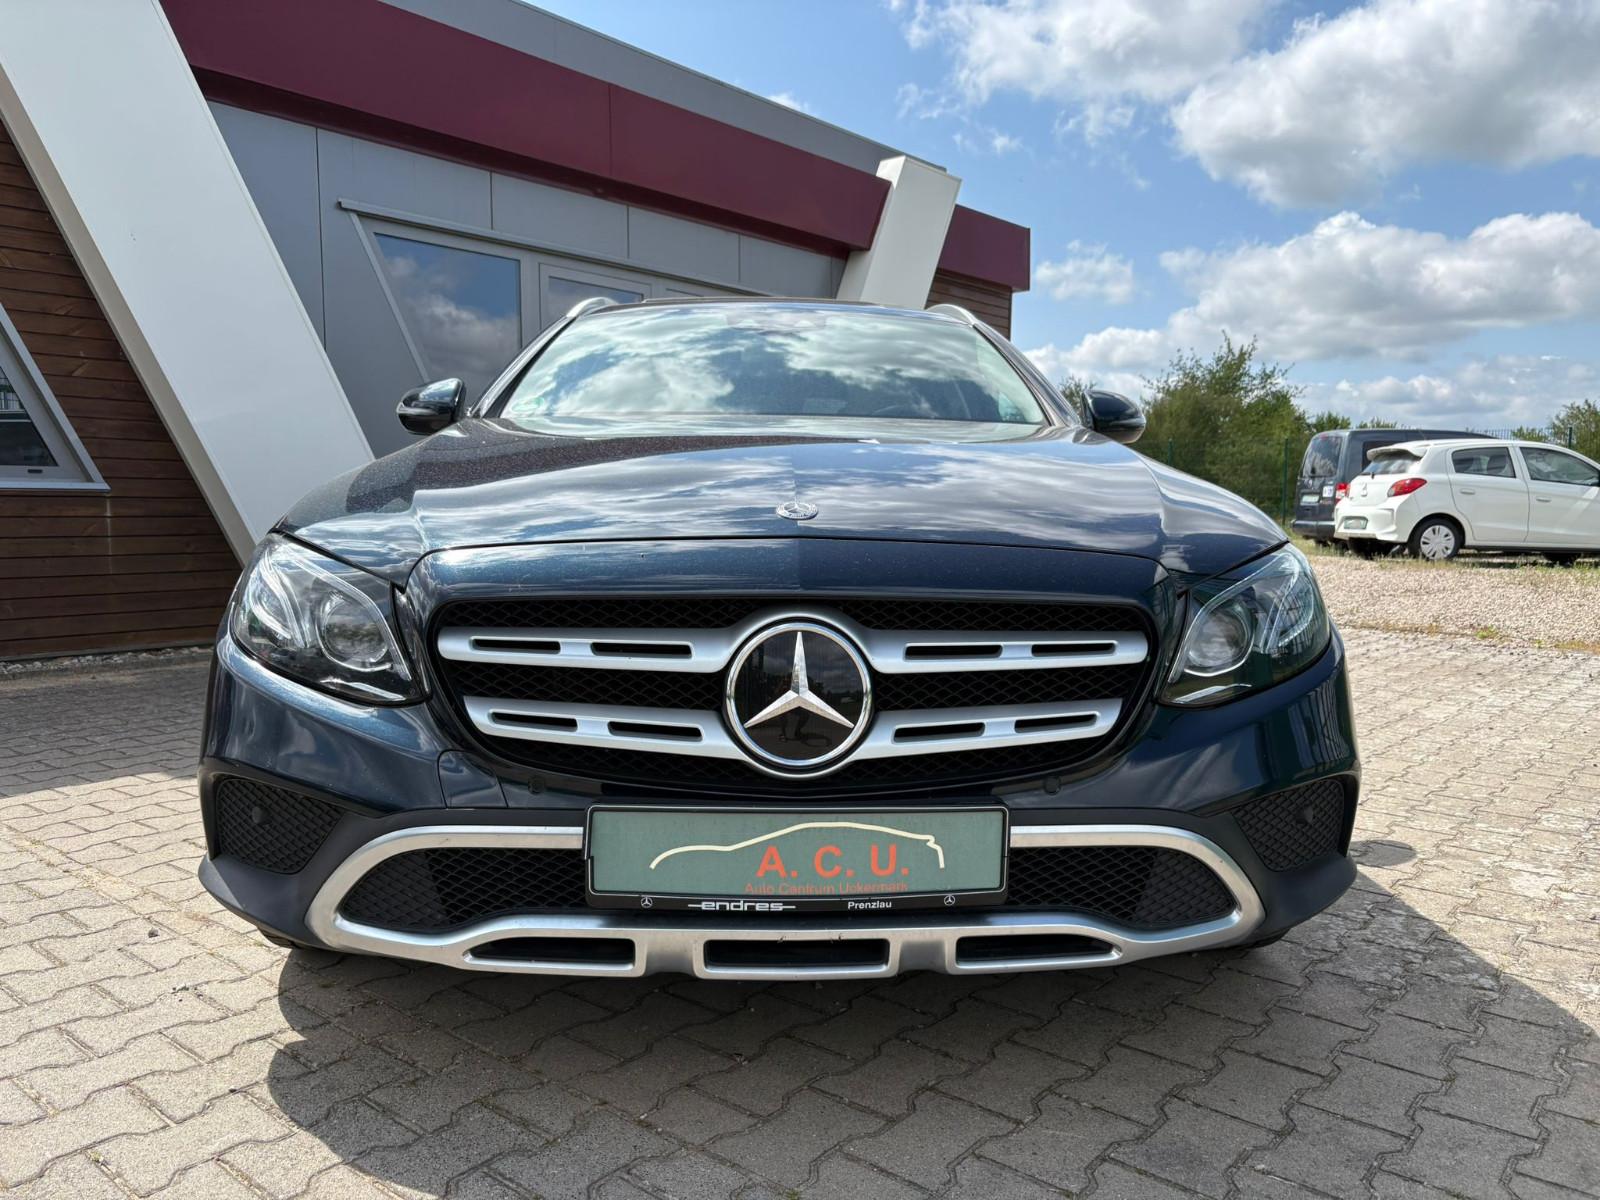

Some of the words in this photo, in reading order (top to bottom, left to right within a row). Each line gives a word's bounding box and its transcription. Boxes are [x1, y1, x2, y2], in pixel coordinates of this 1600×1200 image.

[756, 844, 799, 879] A.
[813, 844, 855, 879] C.
[869, 843, 910, 877] U.
[745, 883, 775, 895] Auto
[699, 900, 785, 911] endres
[847, 901, 892, 910] Prenzlau
